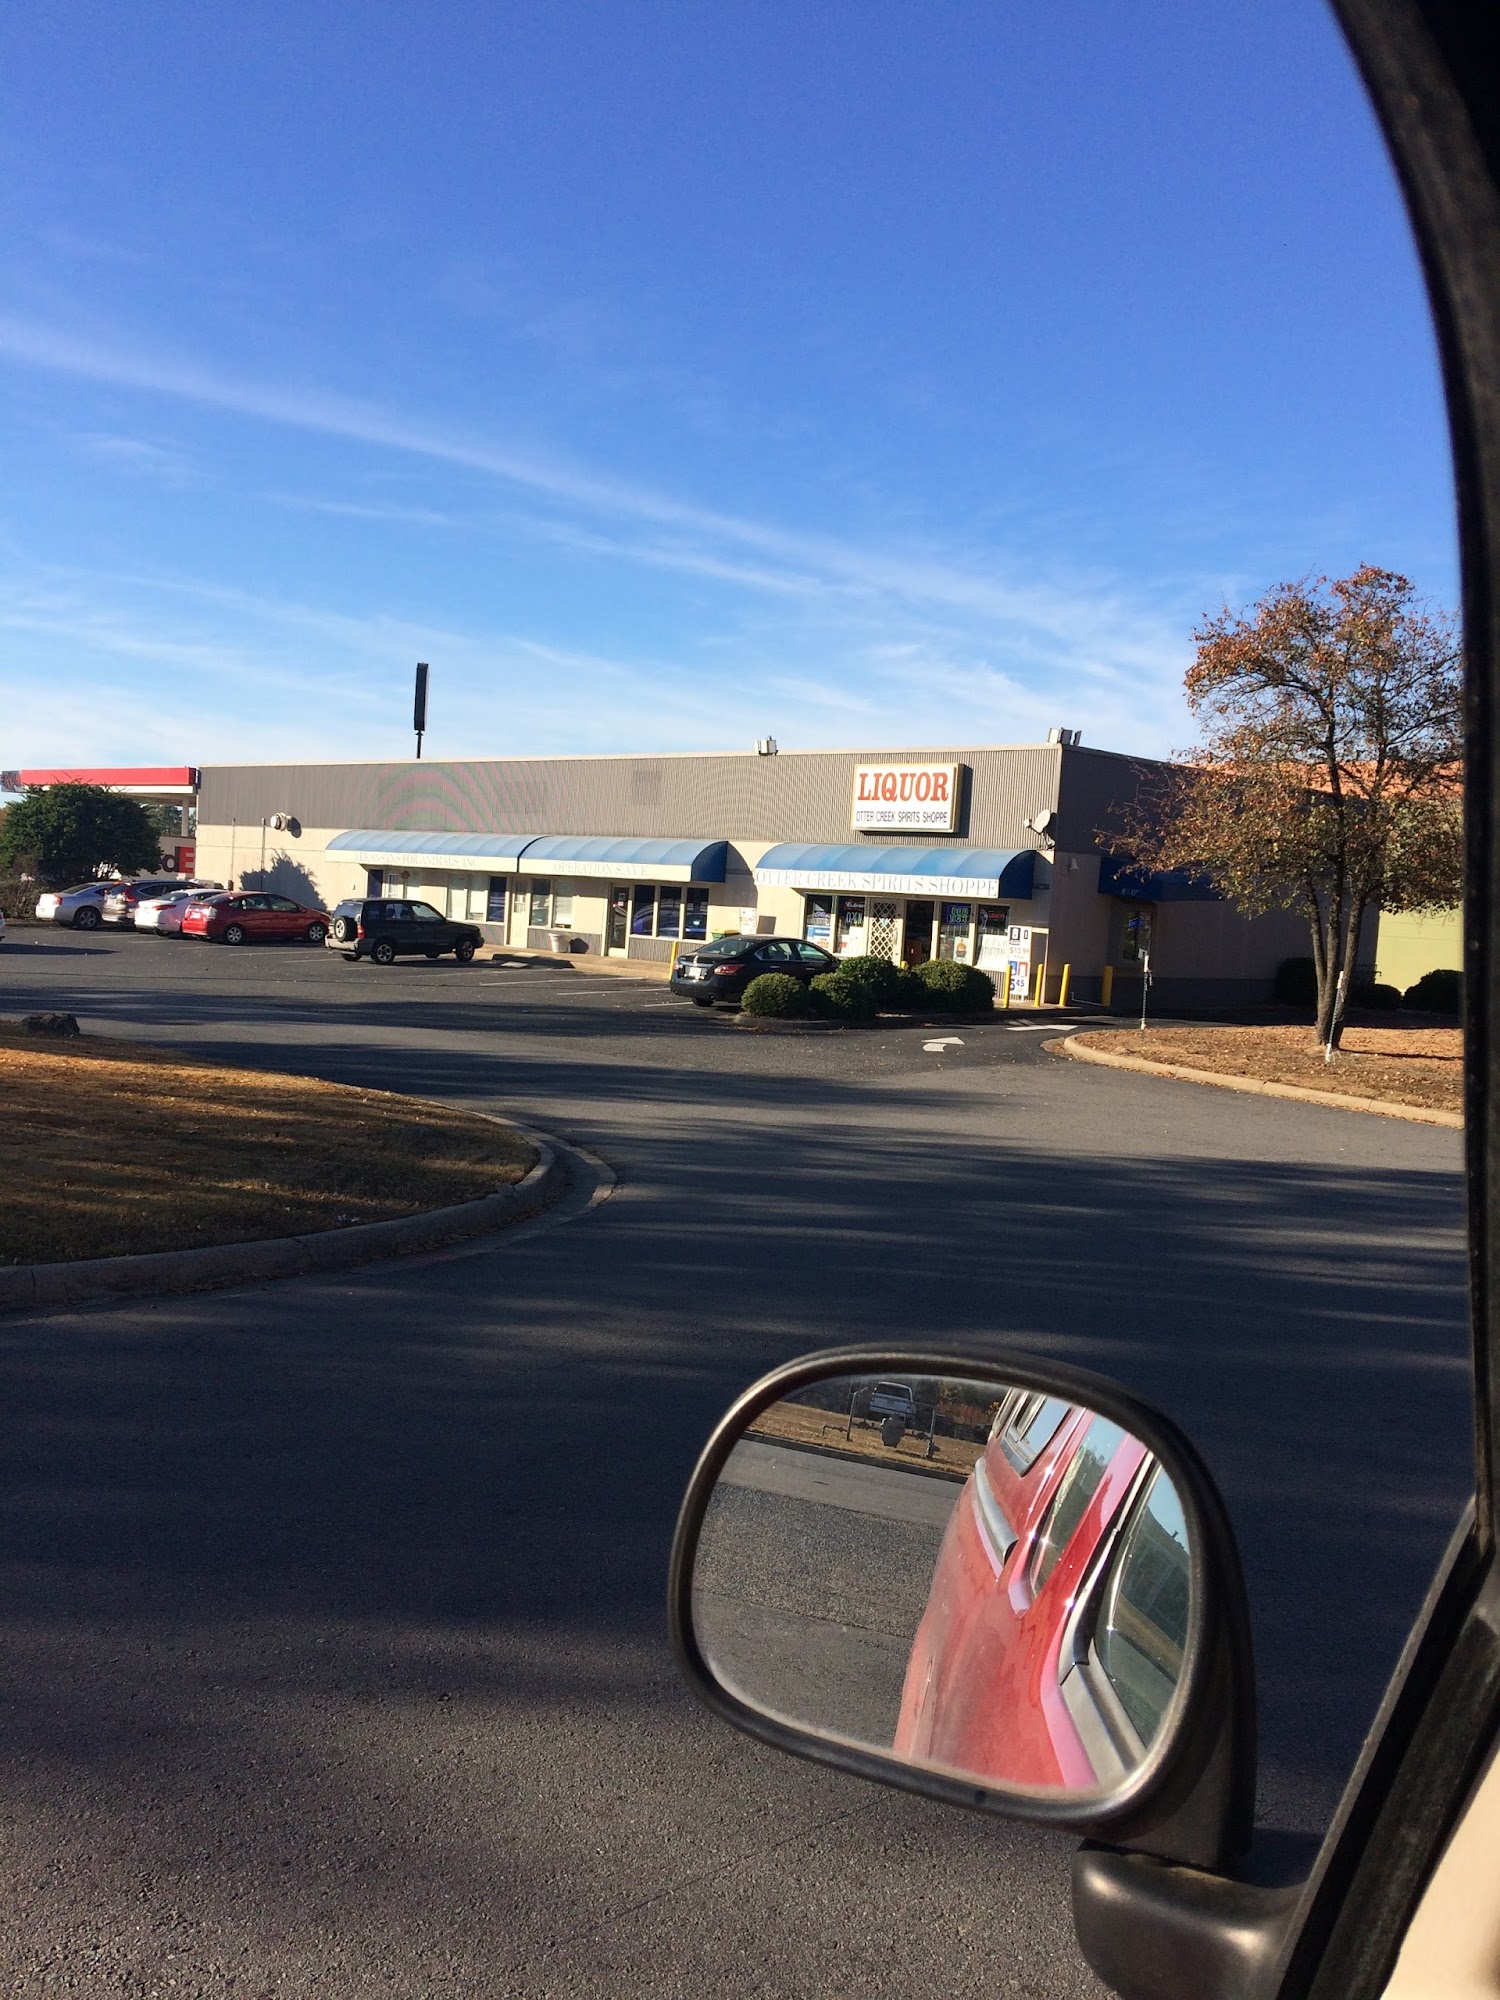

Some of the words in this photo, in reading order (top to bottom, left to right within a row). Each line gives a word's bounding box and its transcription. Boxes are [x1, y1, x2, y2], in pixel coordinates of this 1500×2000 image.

[857, 772, 949, 802] LIQUOR
[855, 810, 874, 822] OTTER
[876, 811, 895, 822] CREEK
[897, 811, 920, 823] SPIRITS
[922, 811, 948, 823] SHOPPE
[402, 854, 418, 865] FOR
[554, 861, 614, 875] OPERATION
[756, 870, 803, 885] OTTER
[805, 872, 857, 888] CREEK
[861, 875, 924, 892] SPIRITS
[928, 877, 998, 896] SHOPPE
[845, 911, 863, 924] OPEN
